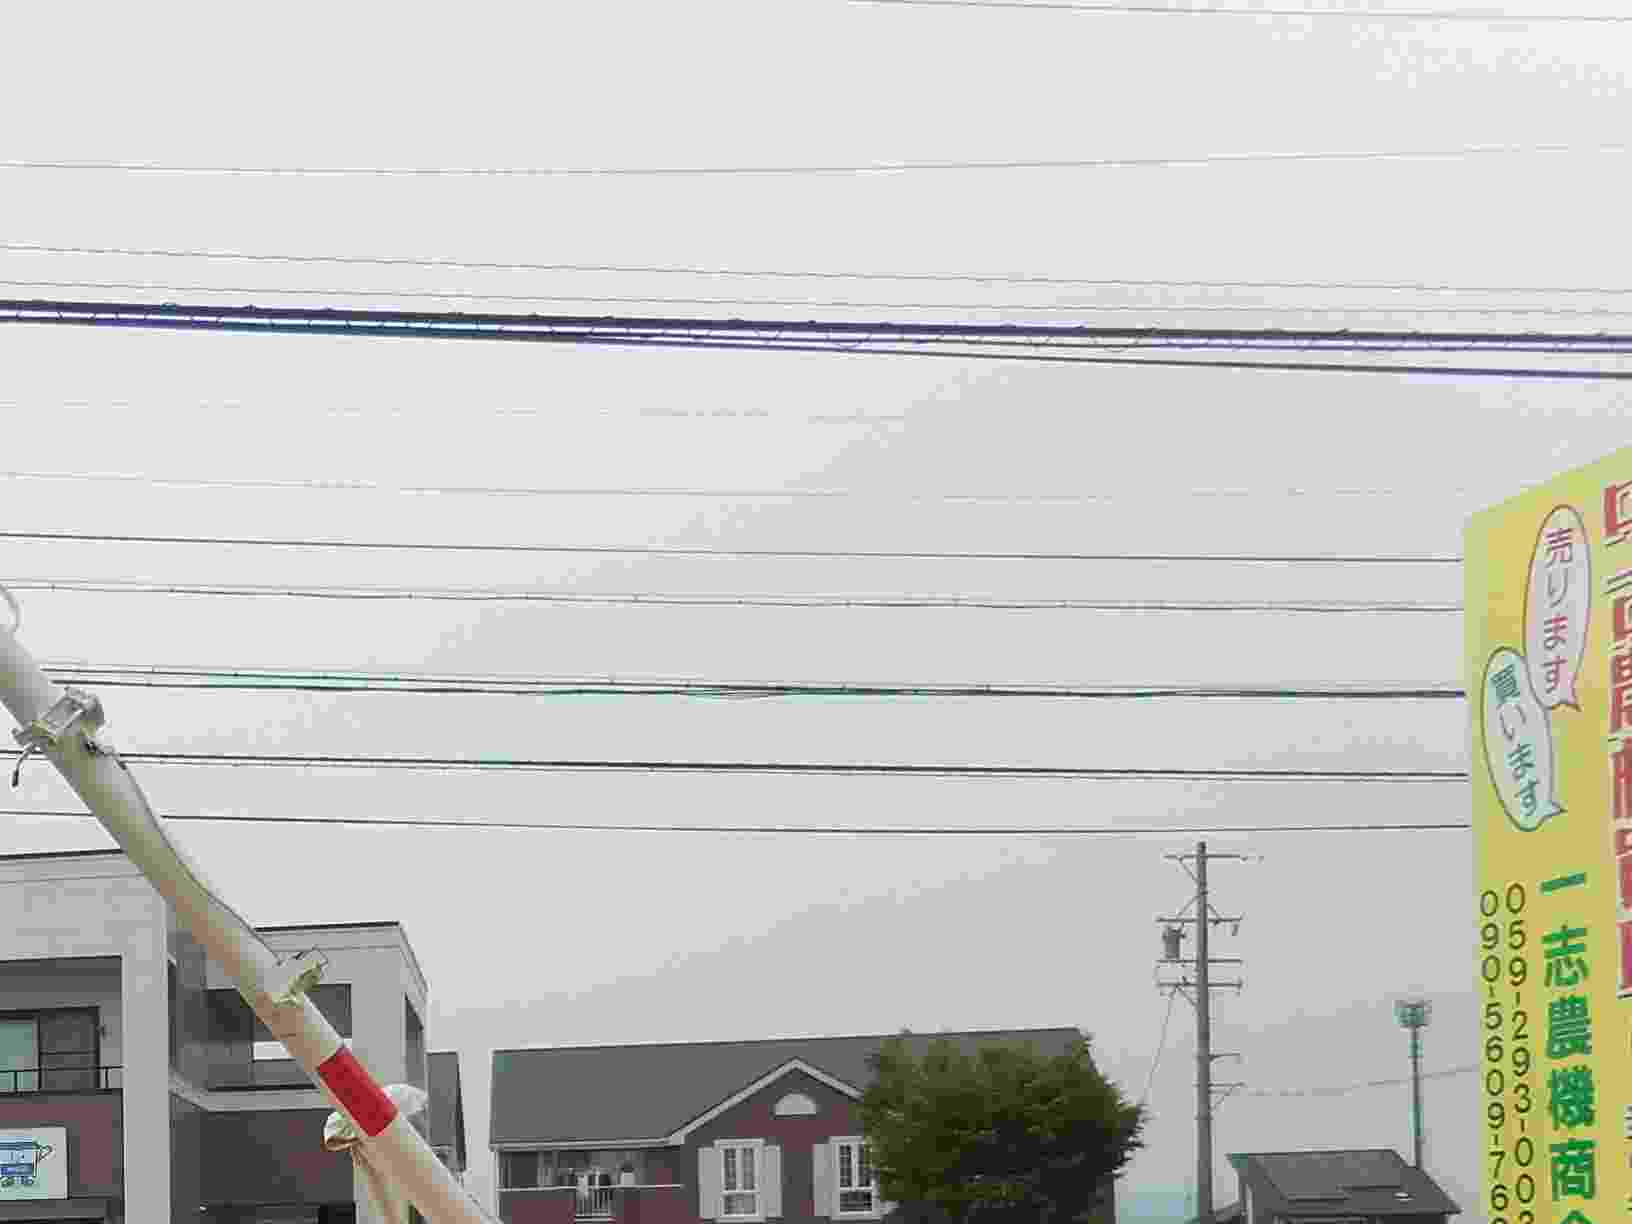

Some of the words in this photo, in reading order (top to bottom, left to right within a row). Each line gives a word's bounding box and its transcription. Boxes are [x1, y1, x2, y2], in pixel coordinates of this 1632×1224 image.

[1542, 527, 1574, 695] 売ります
[1489, 664, 1540, 818] 買います
